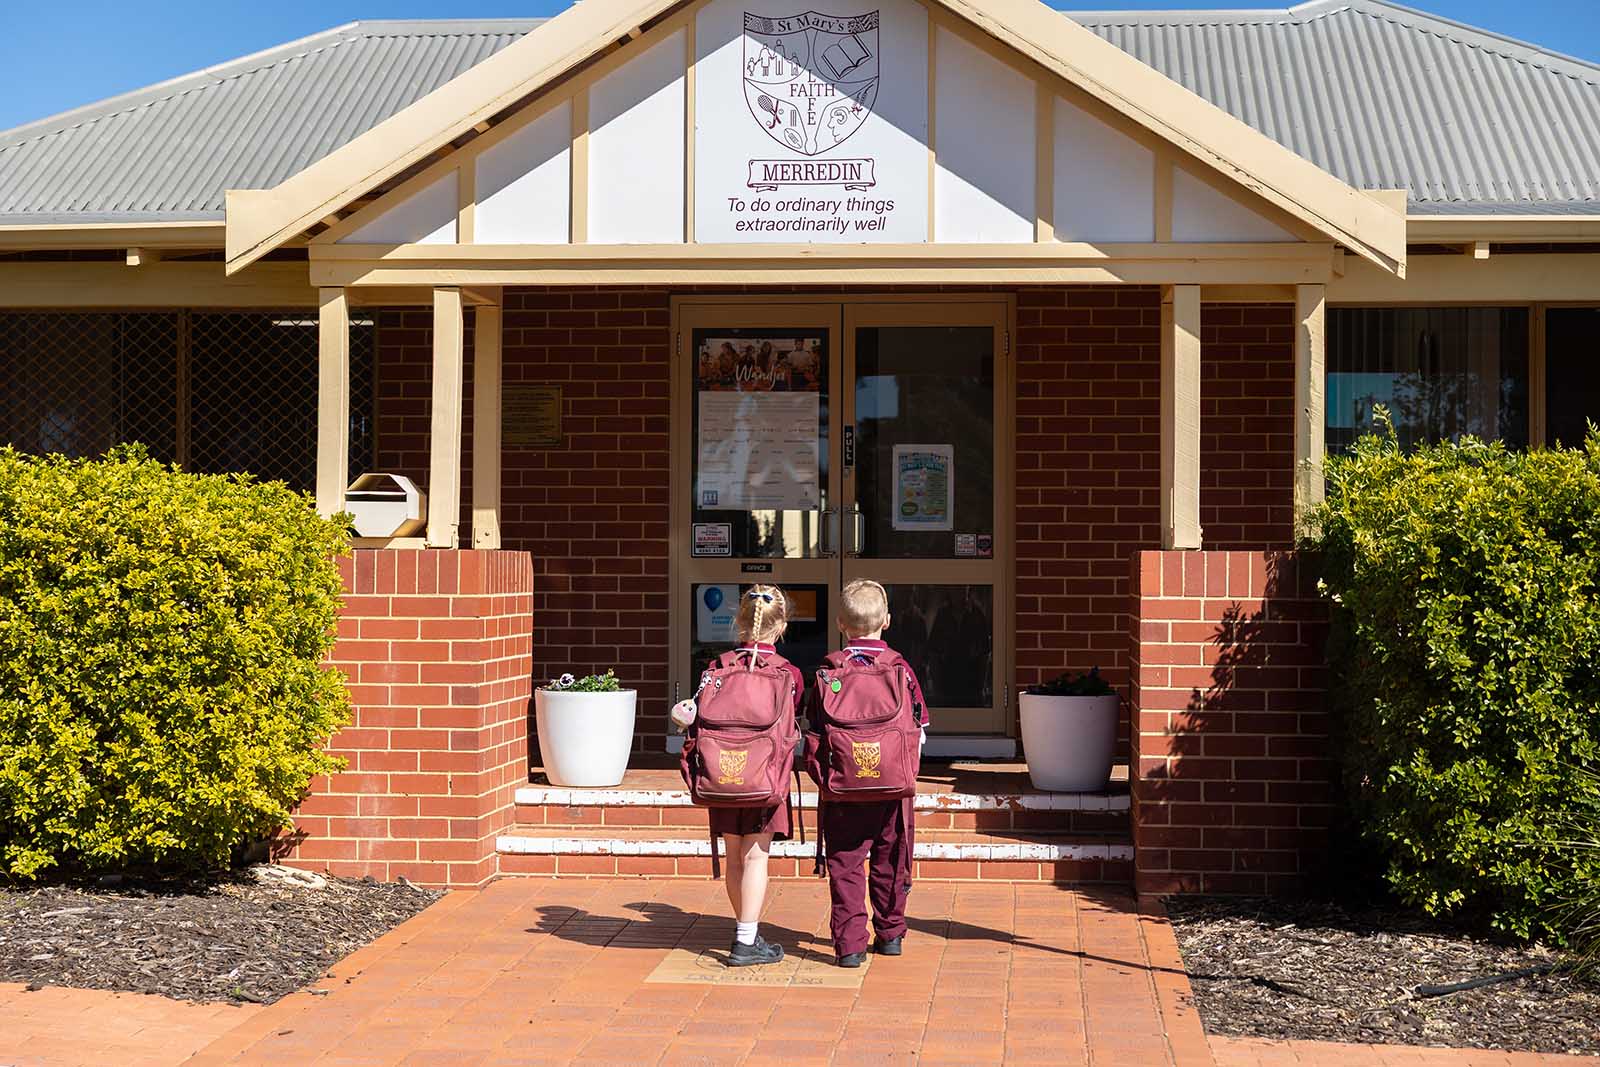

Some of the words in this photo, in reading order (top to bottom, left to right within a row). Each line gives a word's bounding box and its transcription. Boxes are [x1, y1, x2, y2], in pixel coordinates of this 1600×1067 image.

[777, 20, 793, 32] St
[797, 15, 845, 32] Mary's
[790, 83, 836, 97] FAITH
[762, 163, 862, 182] MERREDIN
[727, 197, 746, 212] To
[750, 197, 771, 212] do
[775, 197, 841, 217] ordinary
[846, 197, 895, 217] things
[735, 217, 849, 235] extraordinarily
[855, 217, 886, 231] well
[845, 431, 853, 460] PULL
